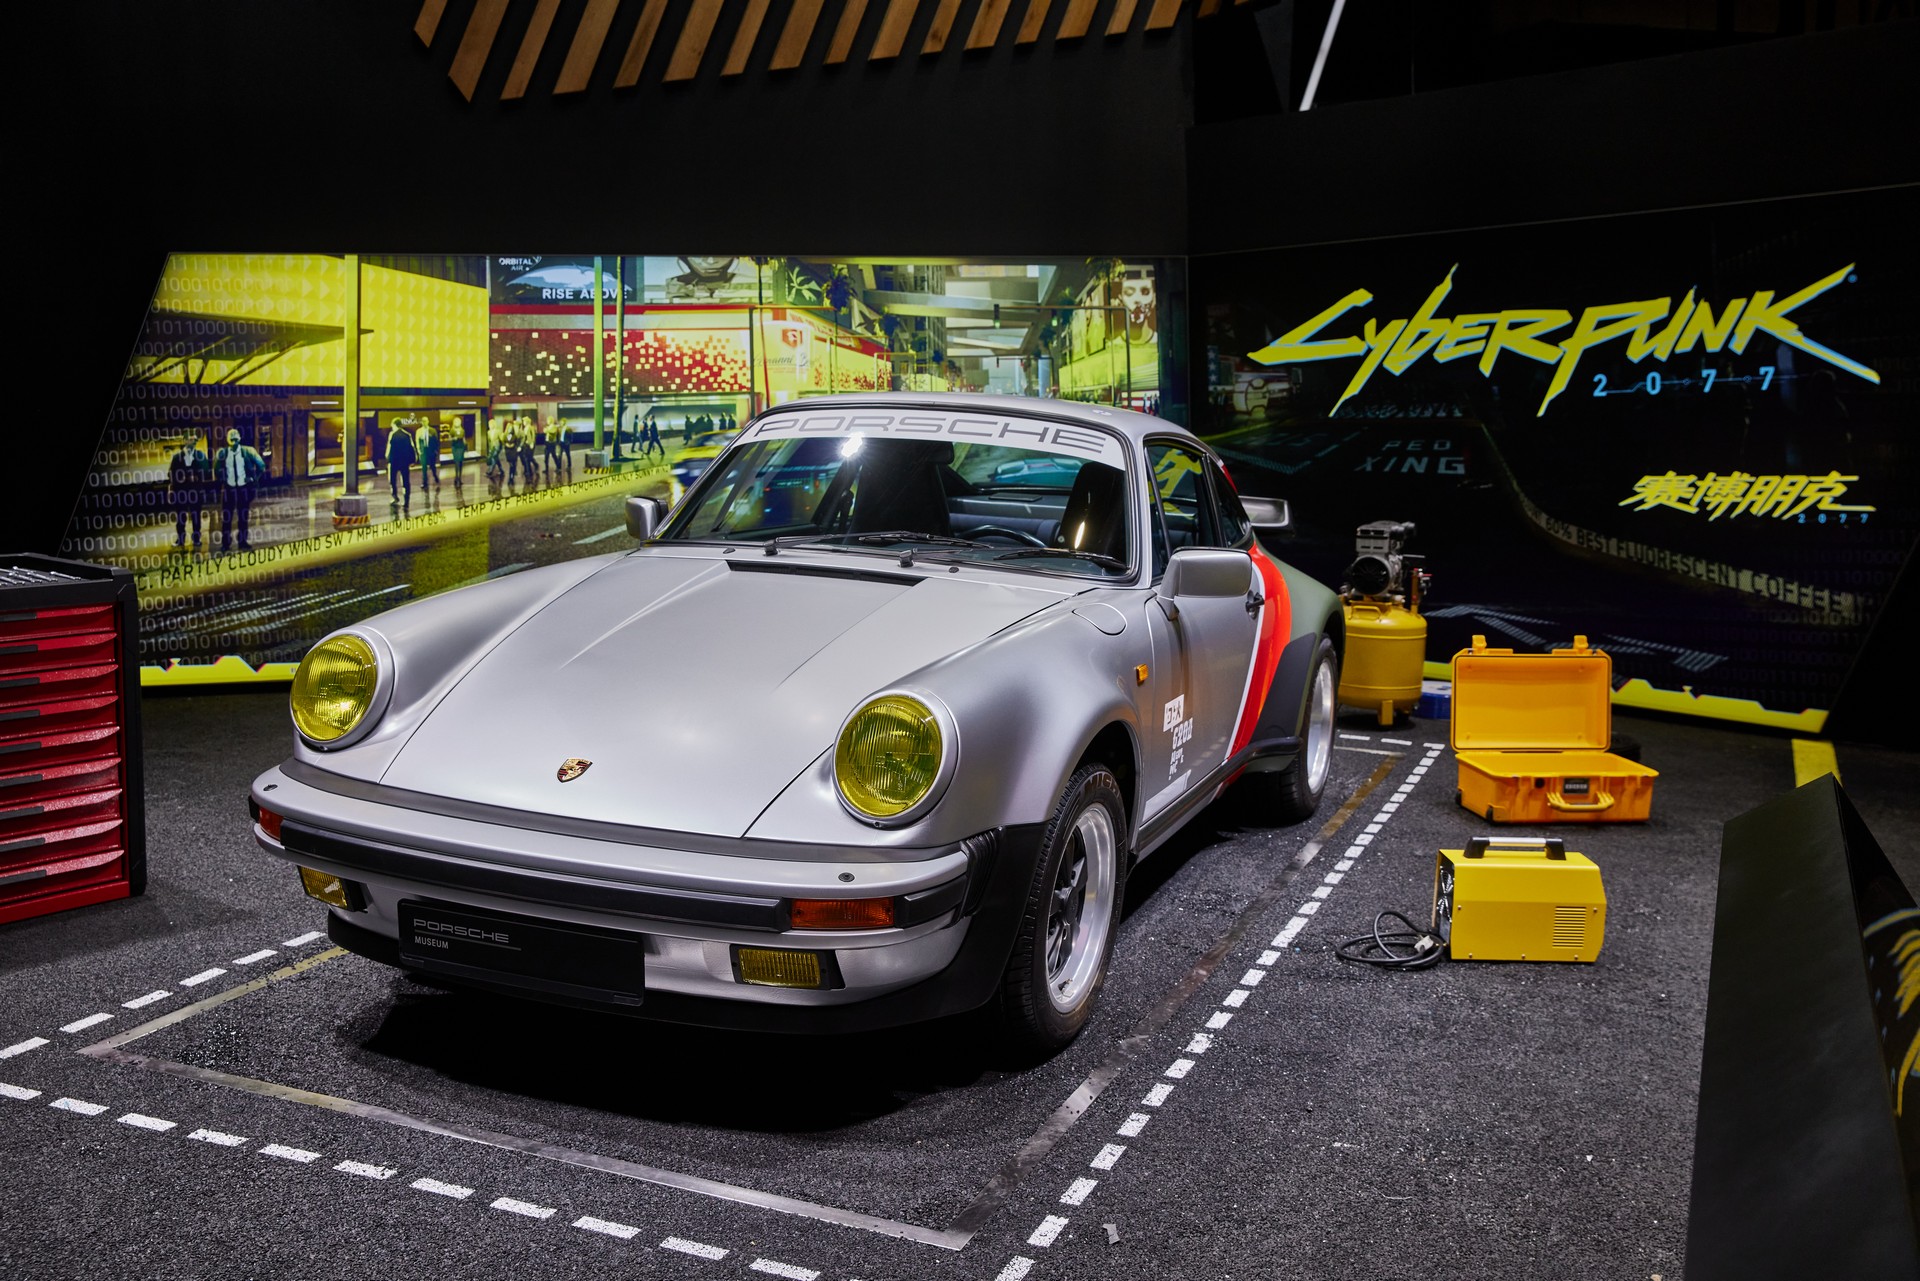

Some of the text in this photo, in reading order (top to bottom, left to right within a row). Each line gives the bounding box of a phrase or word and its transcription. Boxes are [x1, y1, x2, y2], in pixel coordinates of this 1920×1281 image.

[499, 257, 533, 266] ORBITAL
[542, 288, 574, 300] RISE
[753, 415, 1107, 455] PORSCHE
[1381, 439, 1453, 452] PED
[1354, 455, 1466, 476] XING
[1618, 471, 1877, 522] 赛博朋克
[161, 557, 223, 587] PARTLY
[228, 548, 284, 571] CLOUDY
[289, 537, 321, 558] WIND
[325, 533, 344, 549] SW
[347, 529, 355, 544] 7
[357, 525, 378, 542] MPH
[382, 517, 425, 537] HUMIDITY
[457, 503, 486, 519] TEMP
[516, 490, 547, 507] PRECIP
[568, 477, 610, 495] TOMORROW
[612, 472, 635, 487] MAINLY
[1798, 513, 1868, 525] 2077
[1577, 527, 1613, 554] BEST
[413, 918, 510, 944] PORSCHE
[414, 935, 449, 949] MUSEUM
